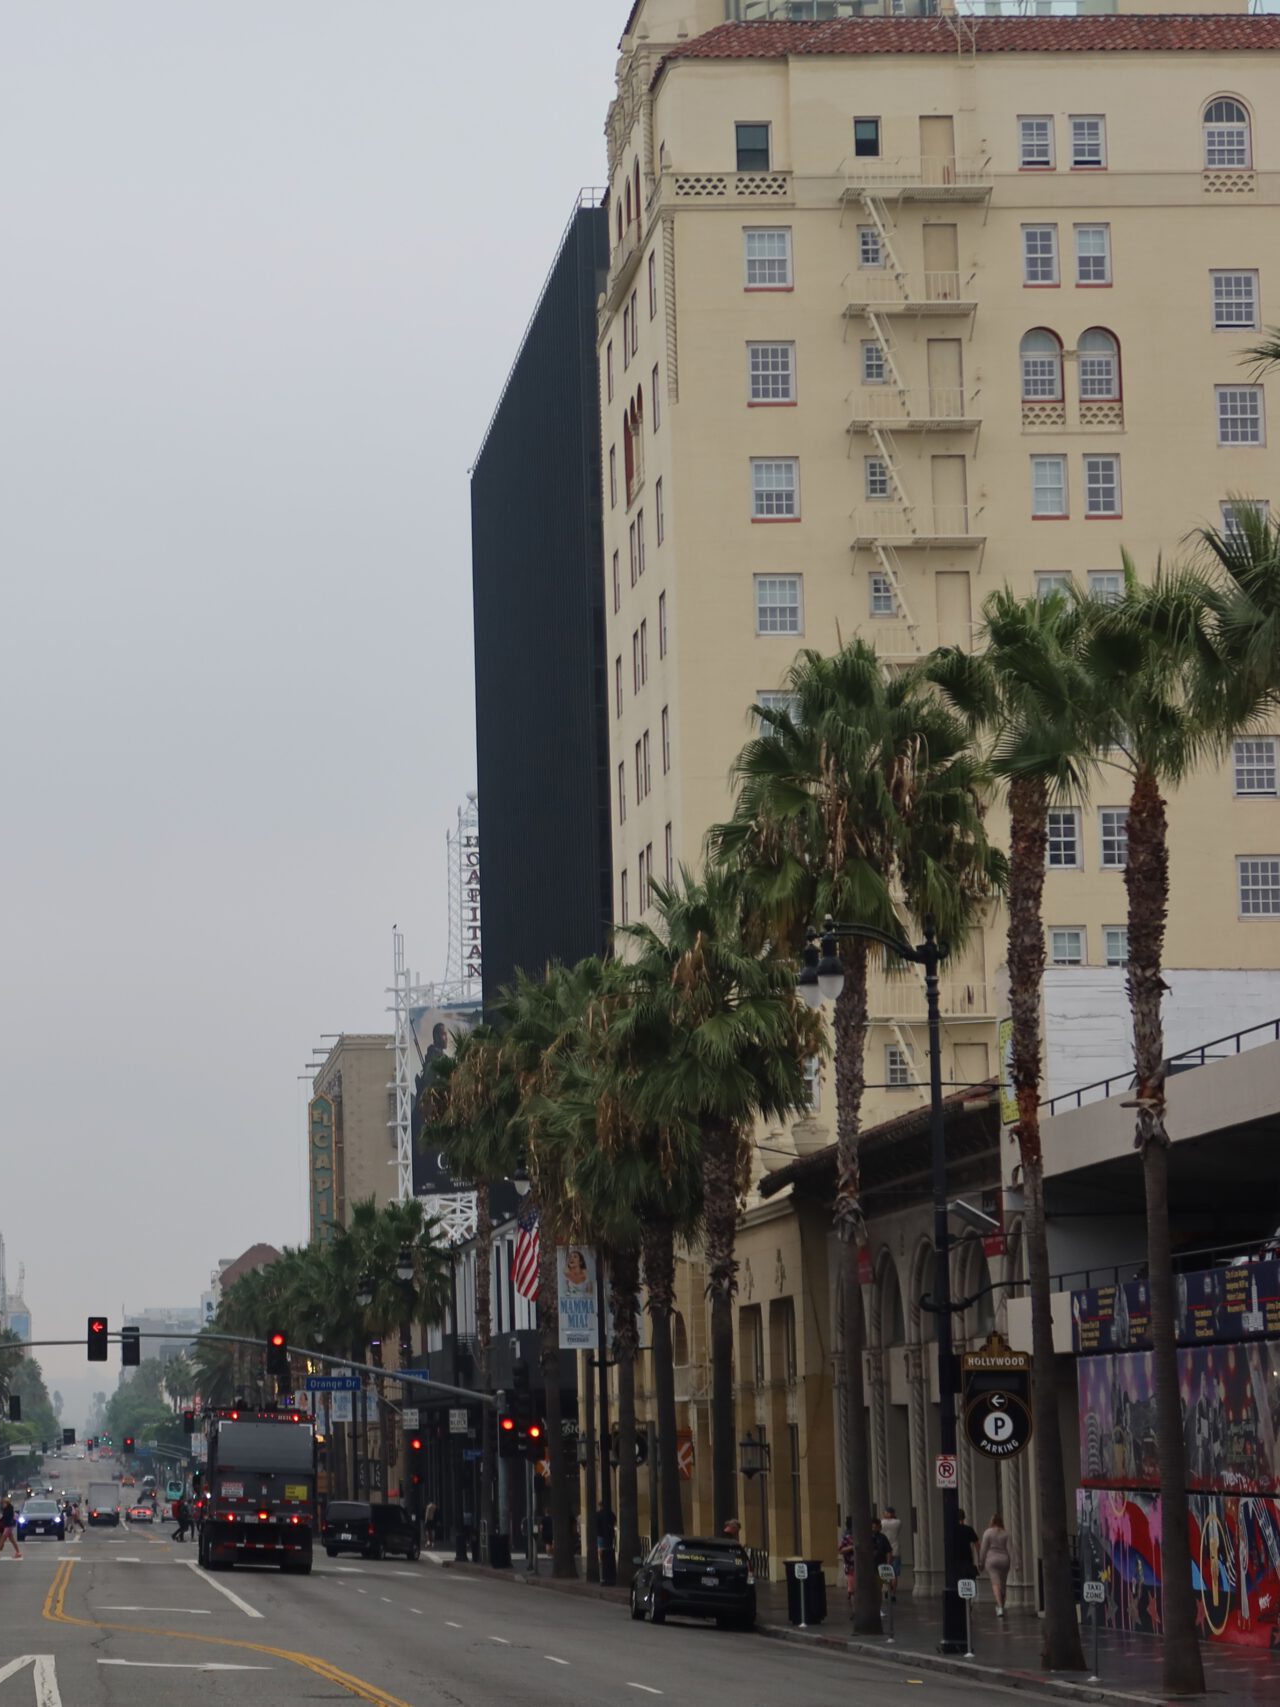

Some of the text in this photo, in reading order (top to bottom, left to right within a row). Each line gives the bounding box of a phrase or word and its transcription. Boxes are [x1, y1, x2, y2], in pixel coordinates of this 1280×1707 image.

[560, 1300, 596, 1314] MAMMA
[567, 1314, 589, 1329] MIA!
[968, 1357, 1025, 1367] HOLLYWOOD
[310, 1379, 356, 1389] Orange Dr
[994, 1417, 1005, 1436] P
[980, 1438, 1020, 1455] PARKING
[1085, 1591, 1103, 1599] ZONE
